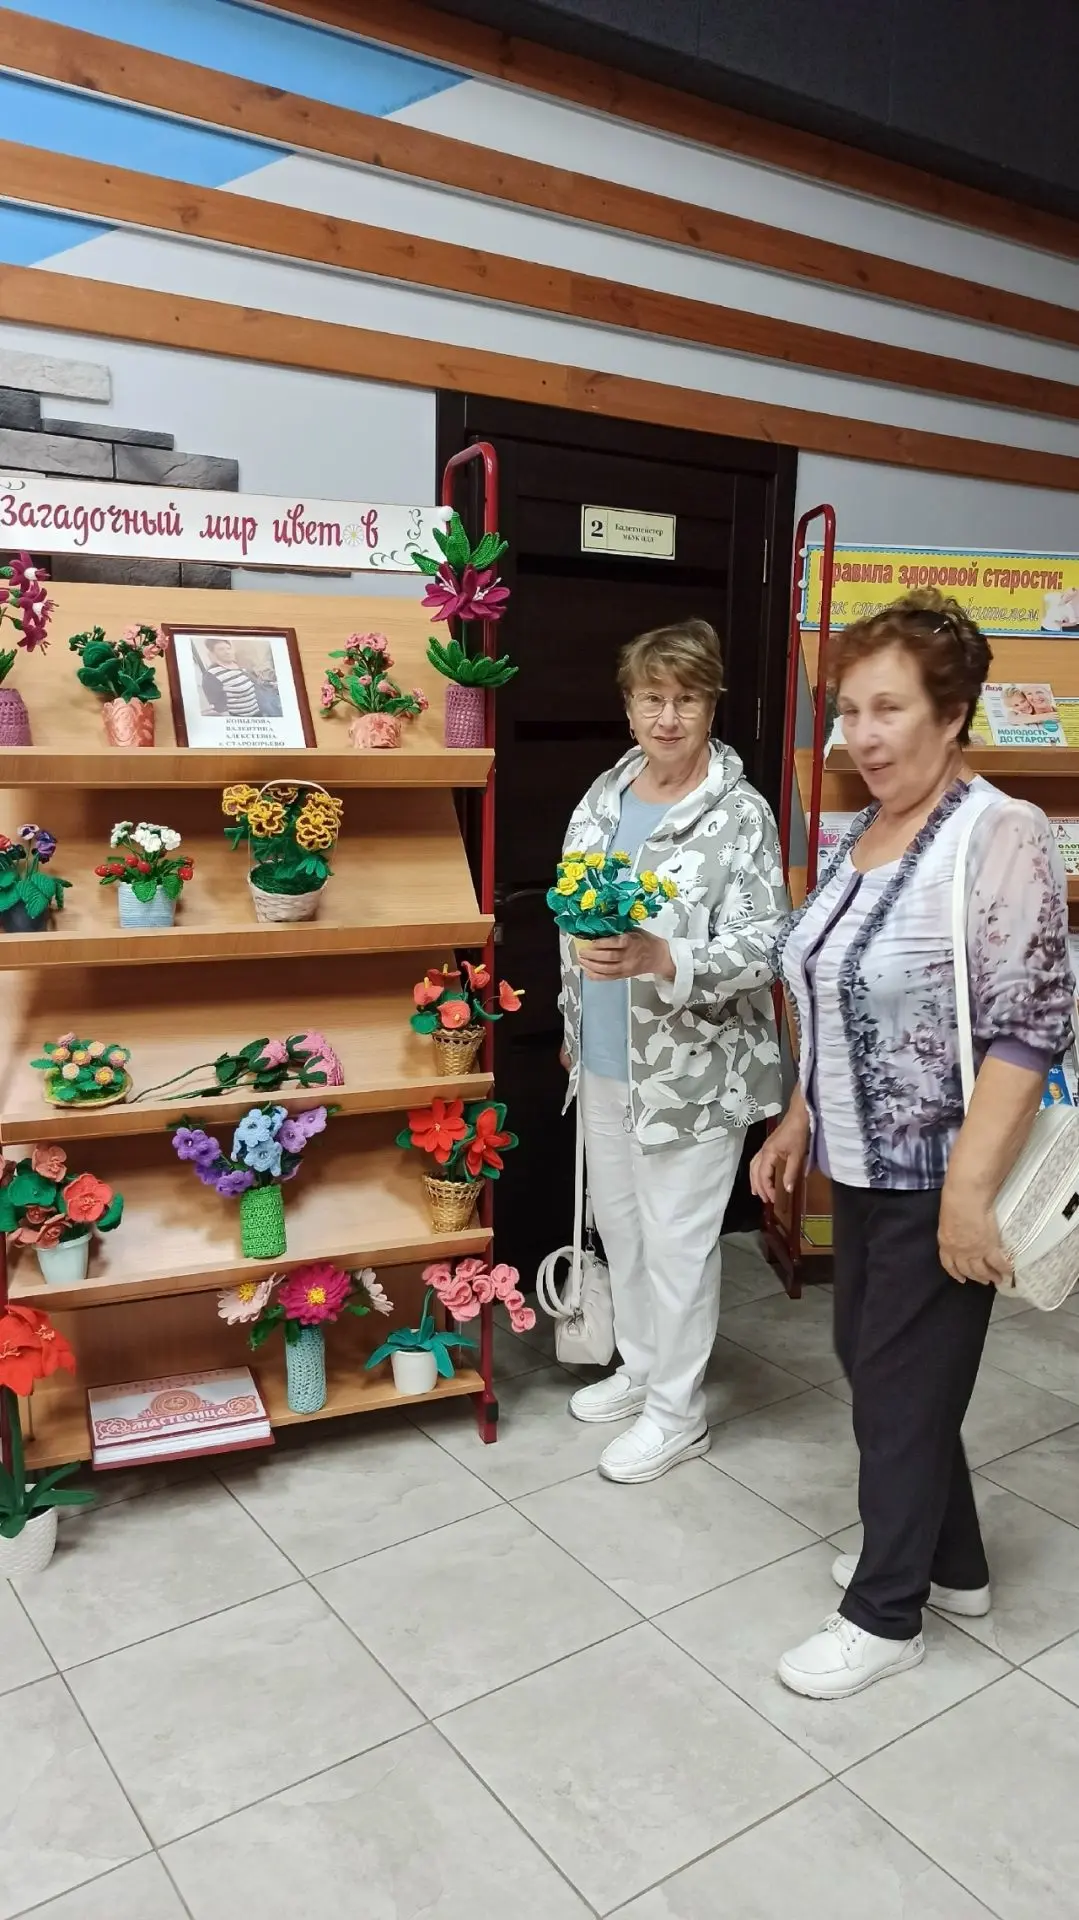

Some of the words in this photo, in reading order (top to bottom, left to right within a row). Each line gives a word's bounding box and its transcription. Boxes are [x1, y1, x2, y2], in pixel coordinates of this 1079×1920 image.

[0, 494, 183, 546] Загадочный
[199, 514, 258, 555] мир
[591, 520, 603, 537] 2
[819, 556, 894, 588] равила
[898, 561, 979, 589] здоровой
[983, 567, 1064, 595] старости:
[817, 600, 848, 616] ак
[999, 736, 1013, 744] ДО
[1014, 736, 1061, 744] СТАРОСТИ
